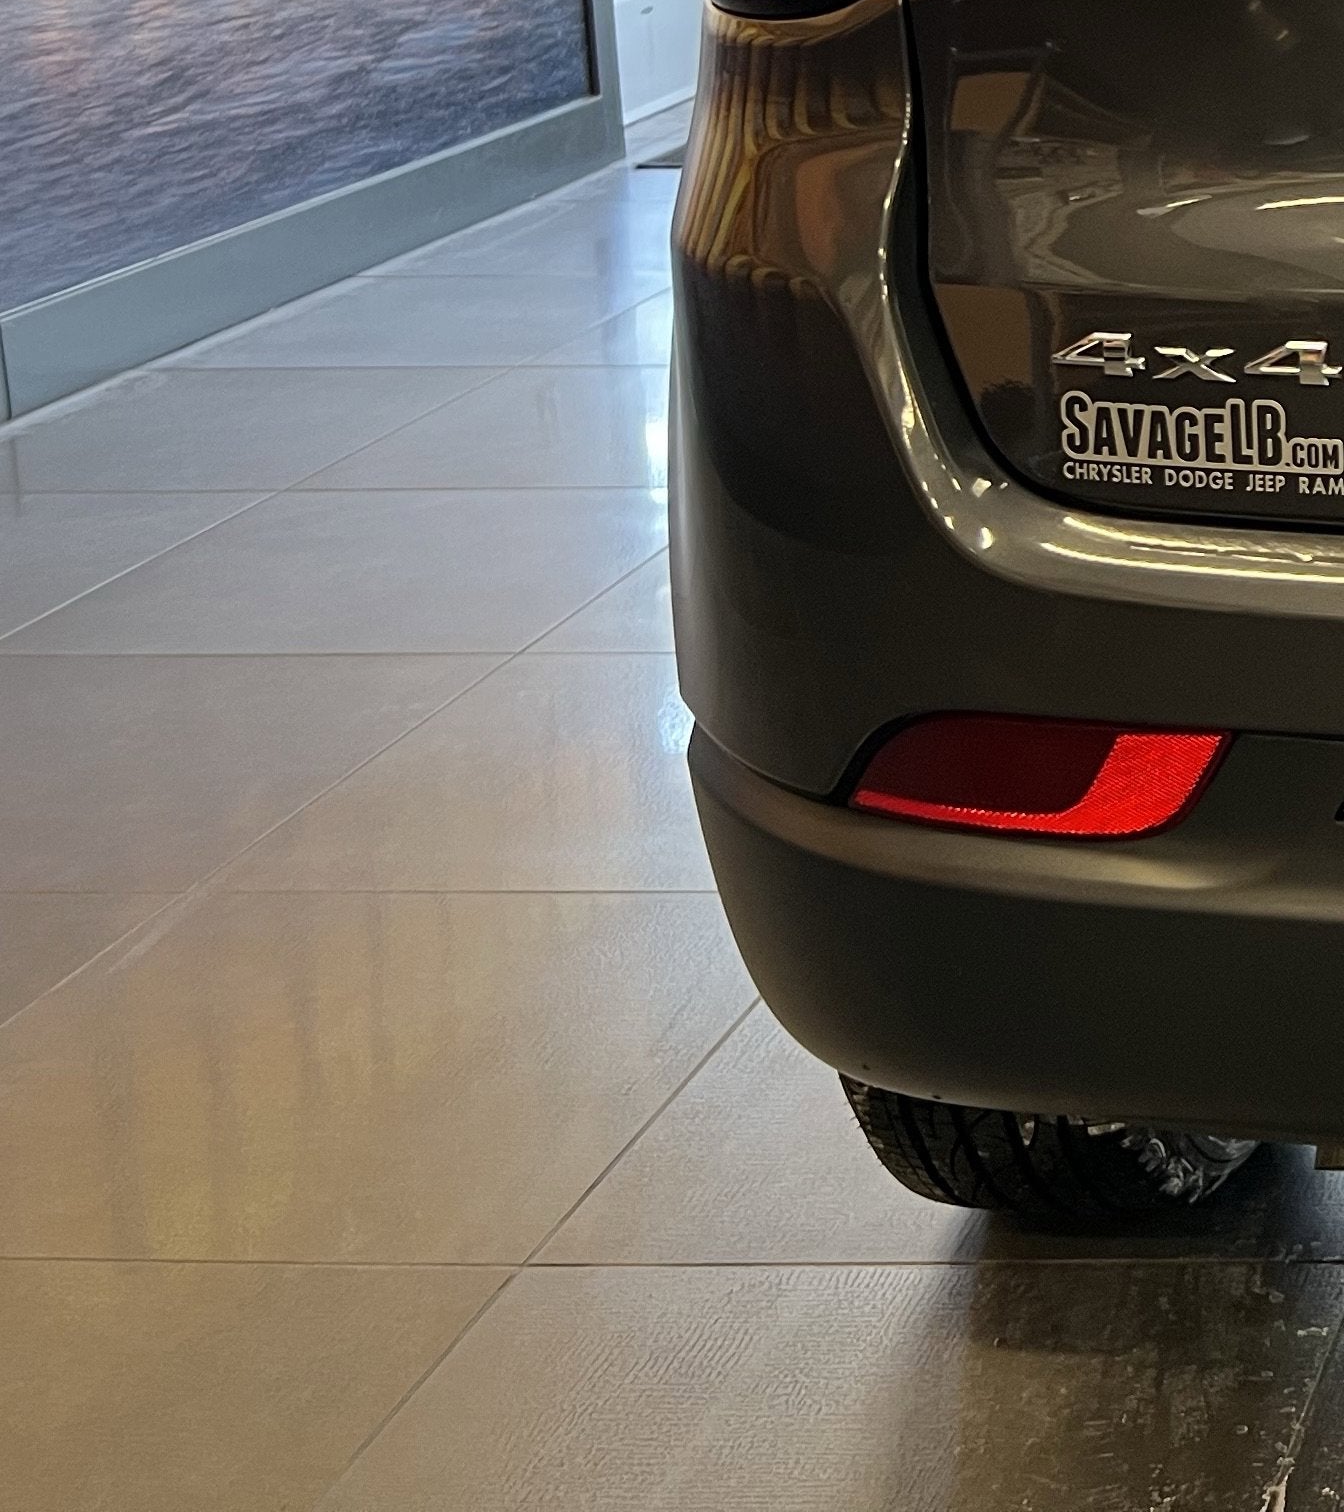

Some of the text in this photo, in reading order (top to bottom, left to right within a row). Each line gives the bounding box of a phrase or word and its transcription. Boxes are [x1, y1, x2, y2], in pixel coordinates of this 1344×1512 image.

[1062, 461, 1153, 485] CHRYSLER
[1164, 470, 1234, 490] DODGE
[1245, 473, 1286, 494] JEEP
